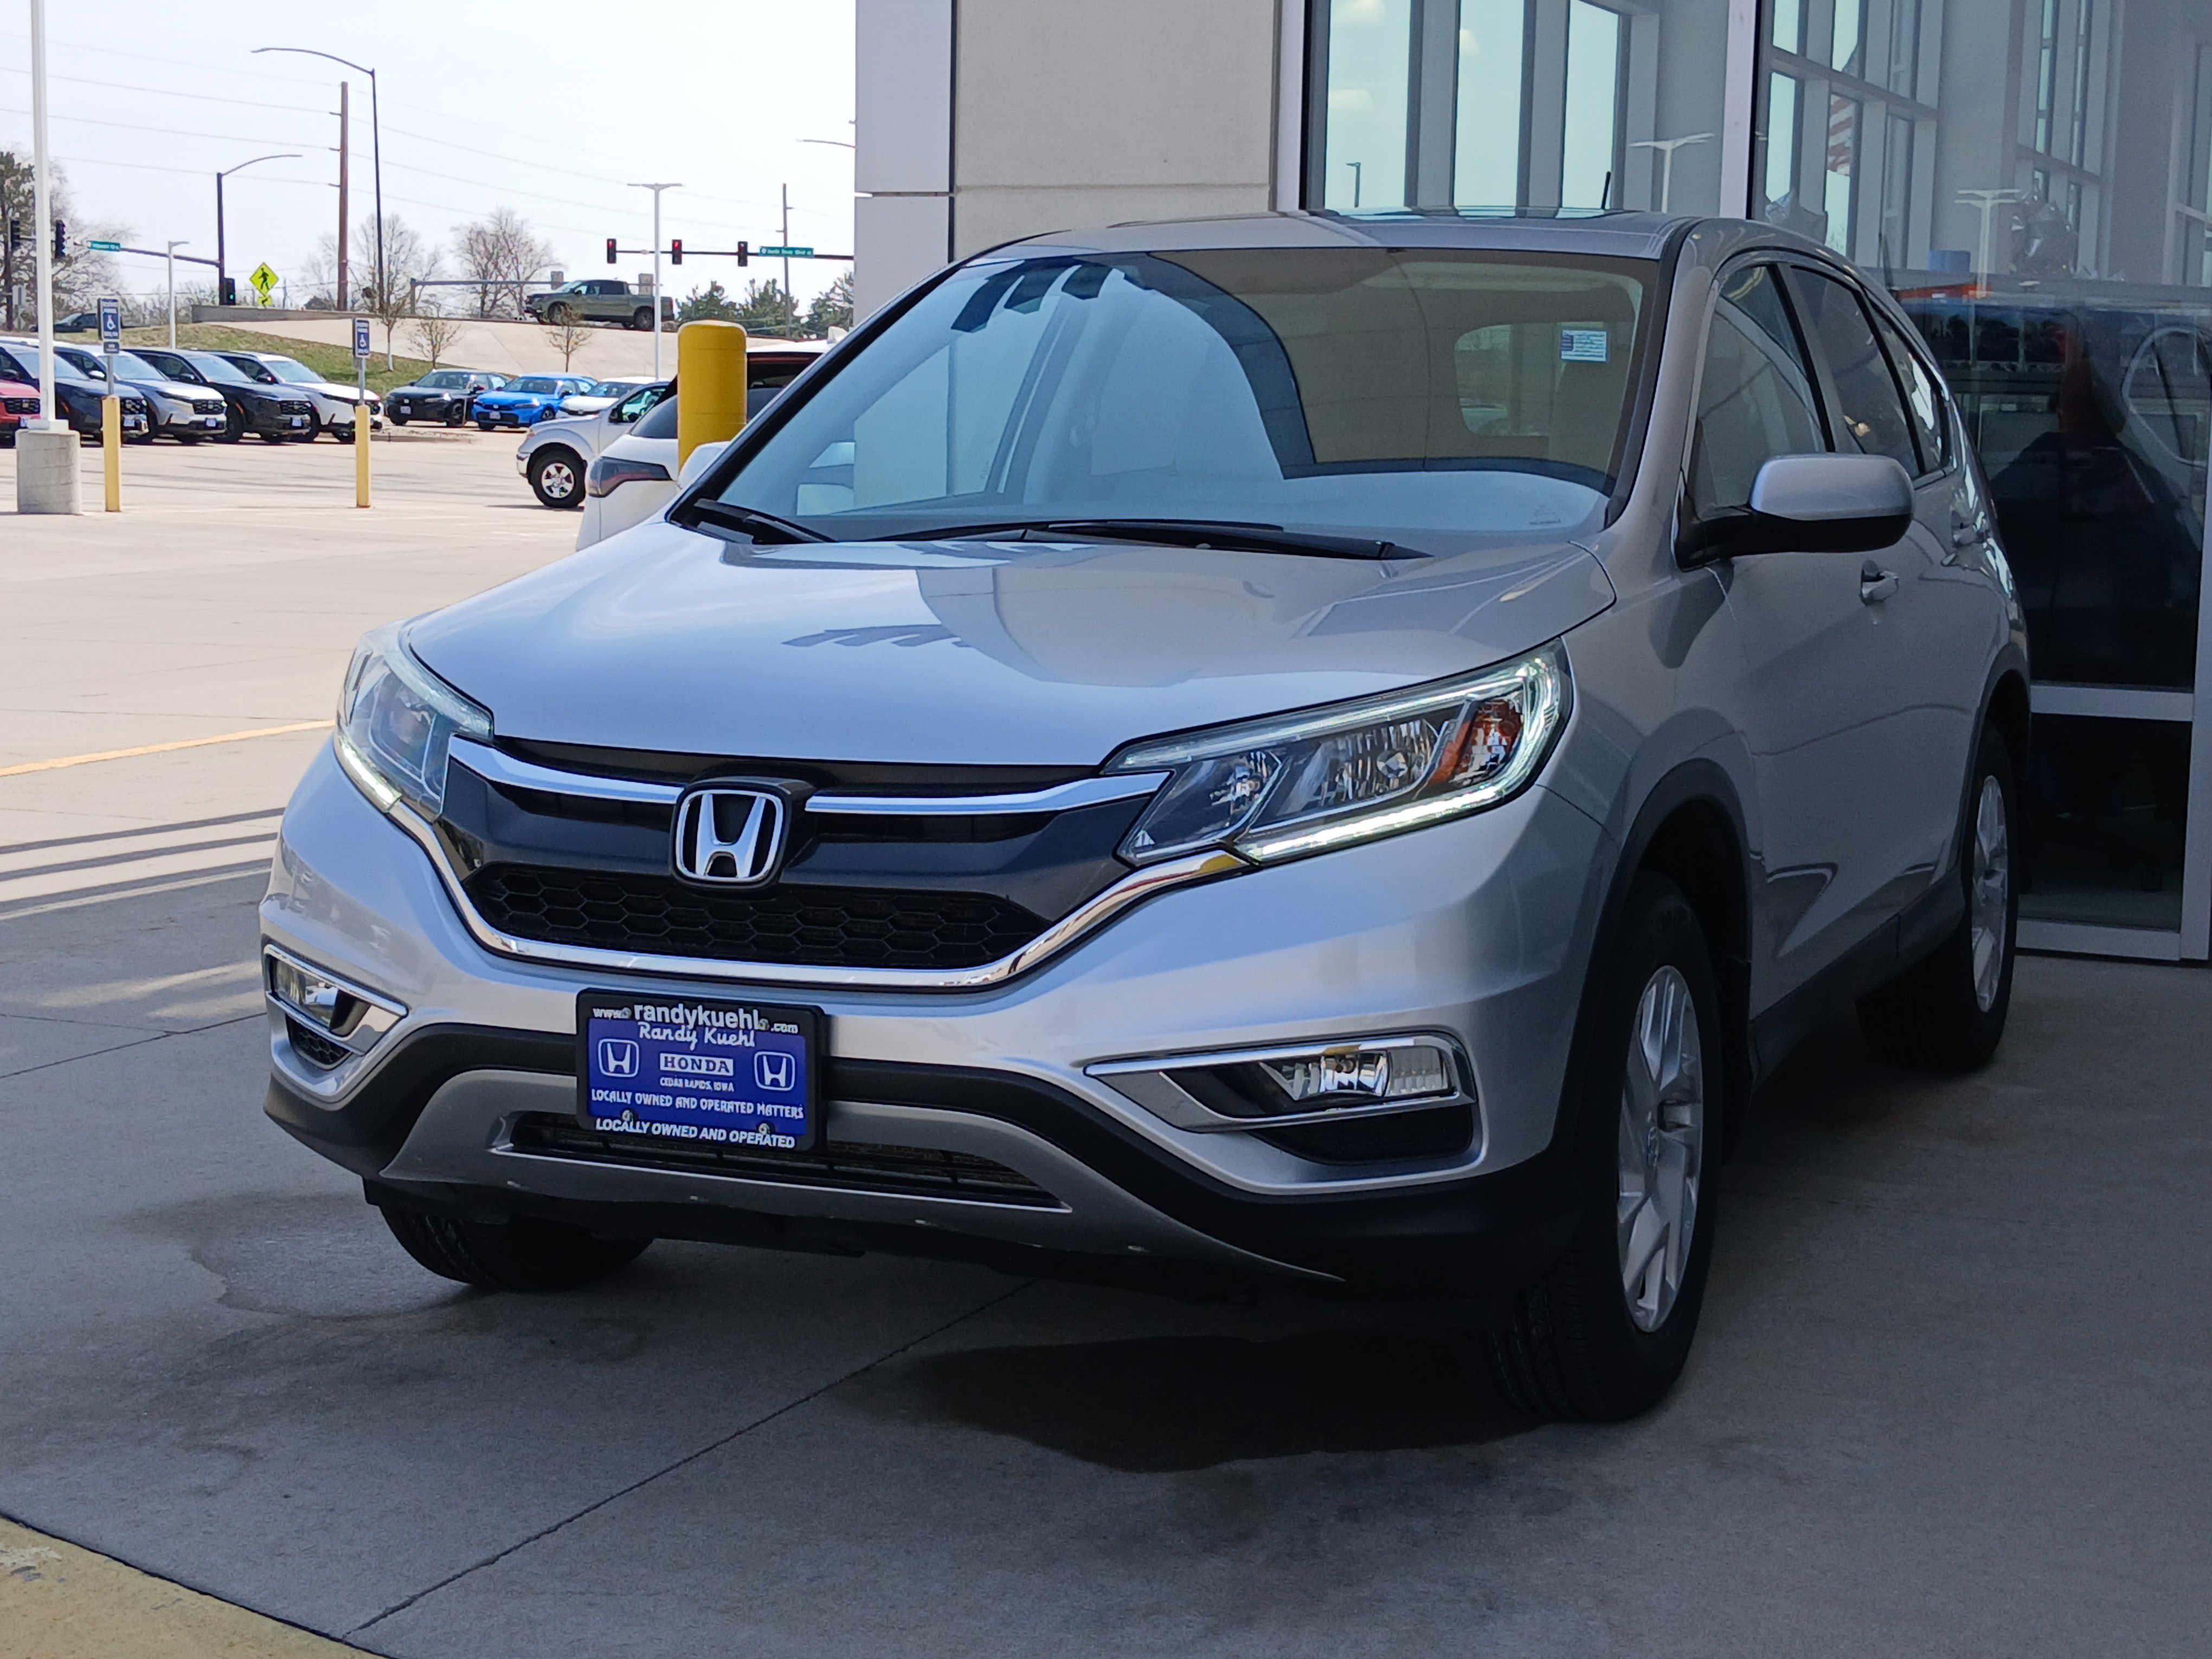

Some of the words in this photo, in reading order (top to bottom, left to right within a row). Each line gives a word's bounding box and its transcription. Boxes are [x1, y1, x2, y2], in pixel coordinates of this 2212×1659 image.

[638, 1022, 697, 1051] Randy
[704, 1027, 755, 1047] Kuehl
[664, 1056, 730, 1073] HONDA
[591, 1089, 632, 1104] LOCALLY
[635, 1093, 672, 1107] OWNED
[676, 1097, 697, 1109] AND
[700, 1098, 754, 1114] OPERATED
[757, 1102, 803, 1119] MATTERS
[596, 1118, 650, 1134] LOCALLY
[652, 1123, 698, 1138] OWNED
[699, 1128, 726, 1141] AND
[729, 1130, 795, 1148] OPERATED
